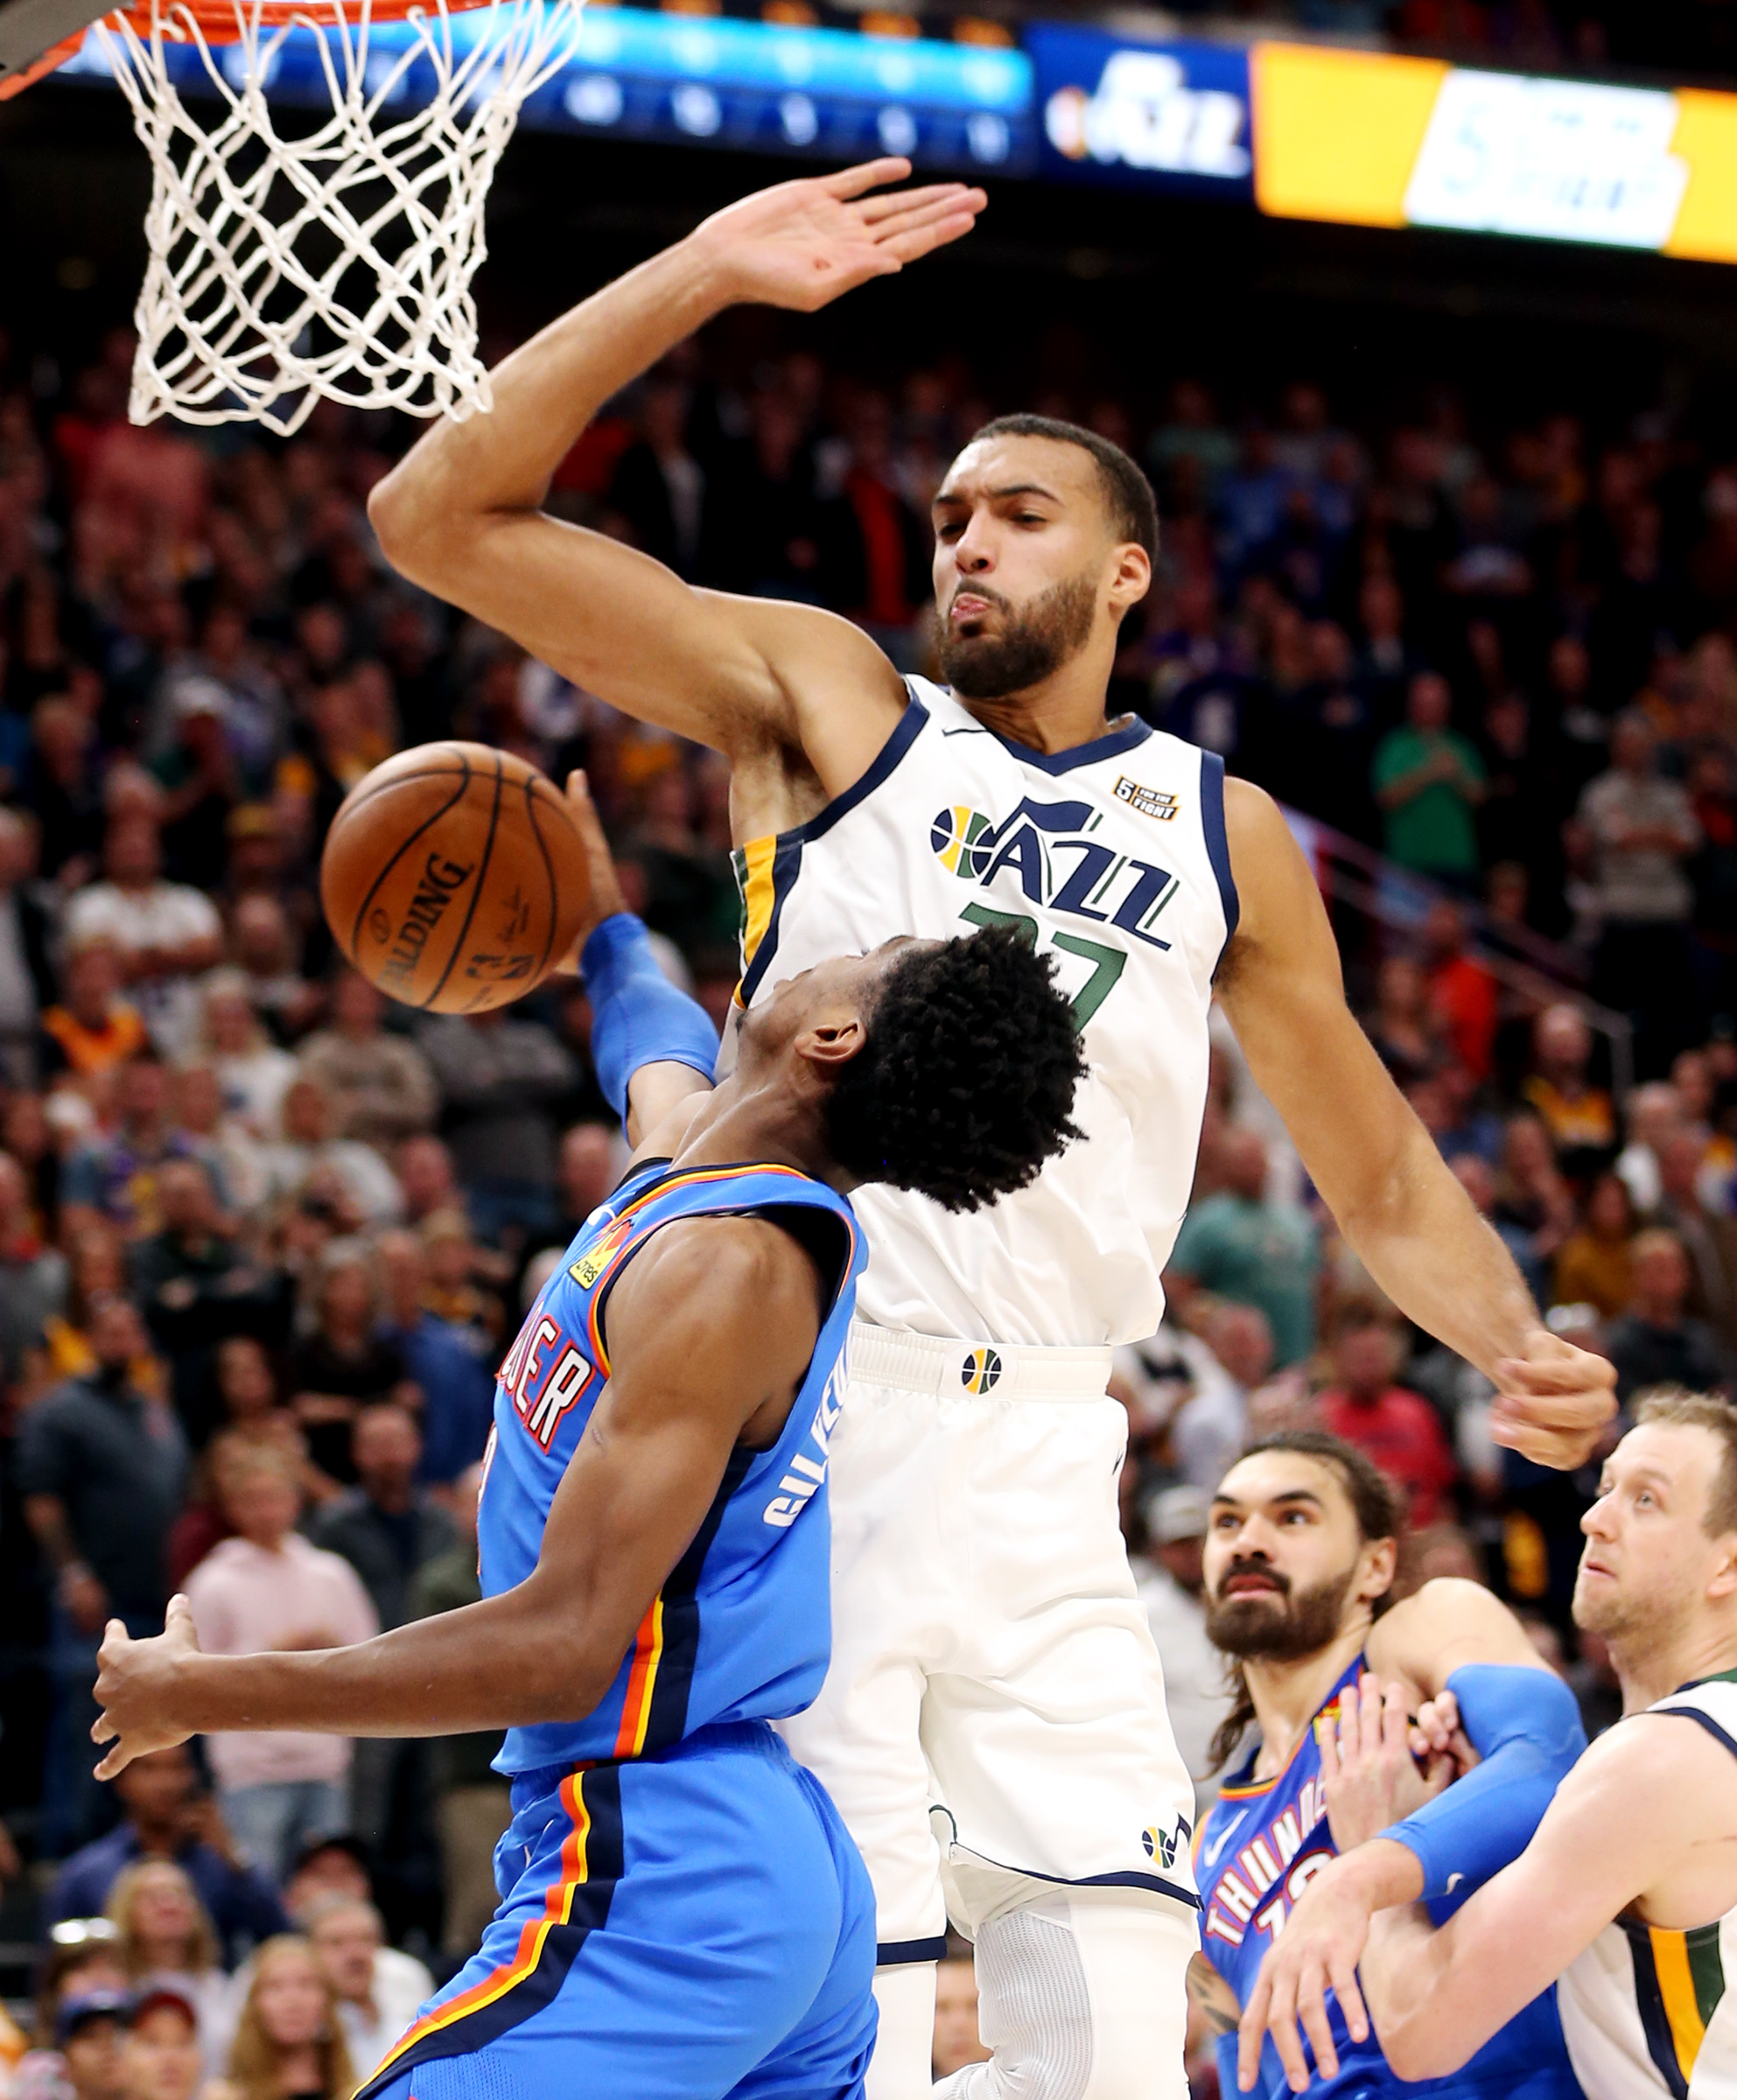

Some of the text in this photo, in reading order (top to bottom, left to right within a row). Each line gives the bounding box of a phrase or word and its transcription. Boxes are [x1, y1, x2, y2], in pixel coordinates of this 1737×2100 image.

[1117, 778, 1135, 801] 5
[1133, 796, 1175, 819] FIGHT
[931, 795, 1180, 951] JAZZ
